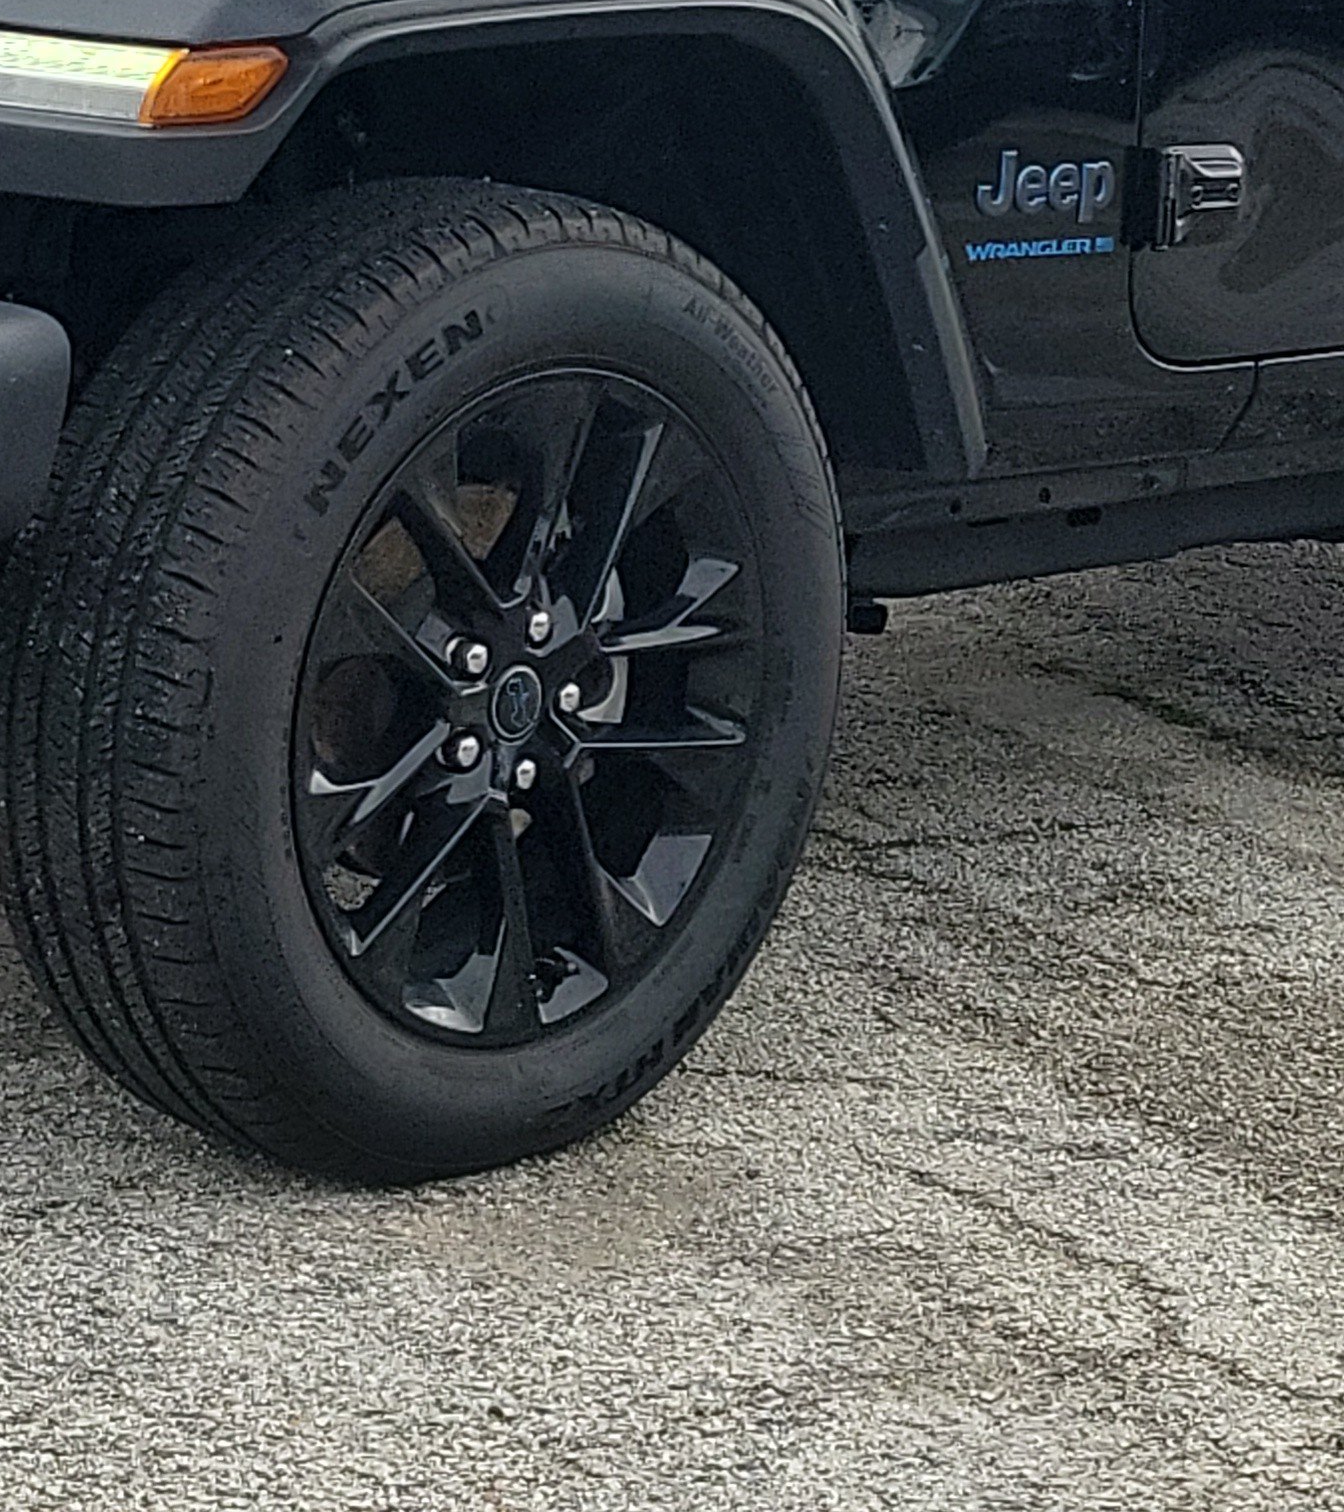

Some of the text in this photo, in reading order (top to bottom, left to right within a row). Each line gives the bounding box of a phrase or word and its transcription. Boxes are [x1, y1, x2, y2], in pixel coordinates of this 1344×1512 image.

[976, 149, 1116, 224] Jeep
[965, 238, 1092, 261] WRANGLER
[305, 309, 484, 518] NEXEN
